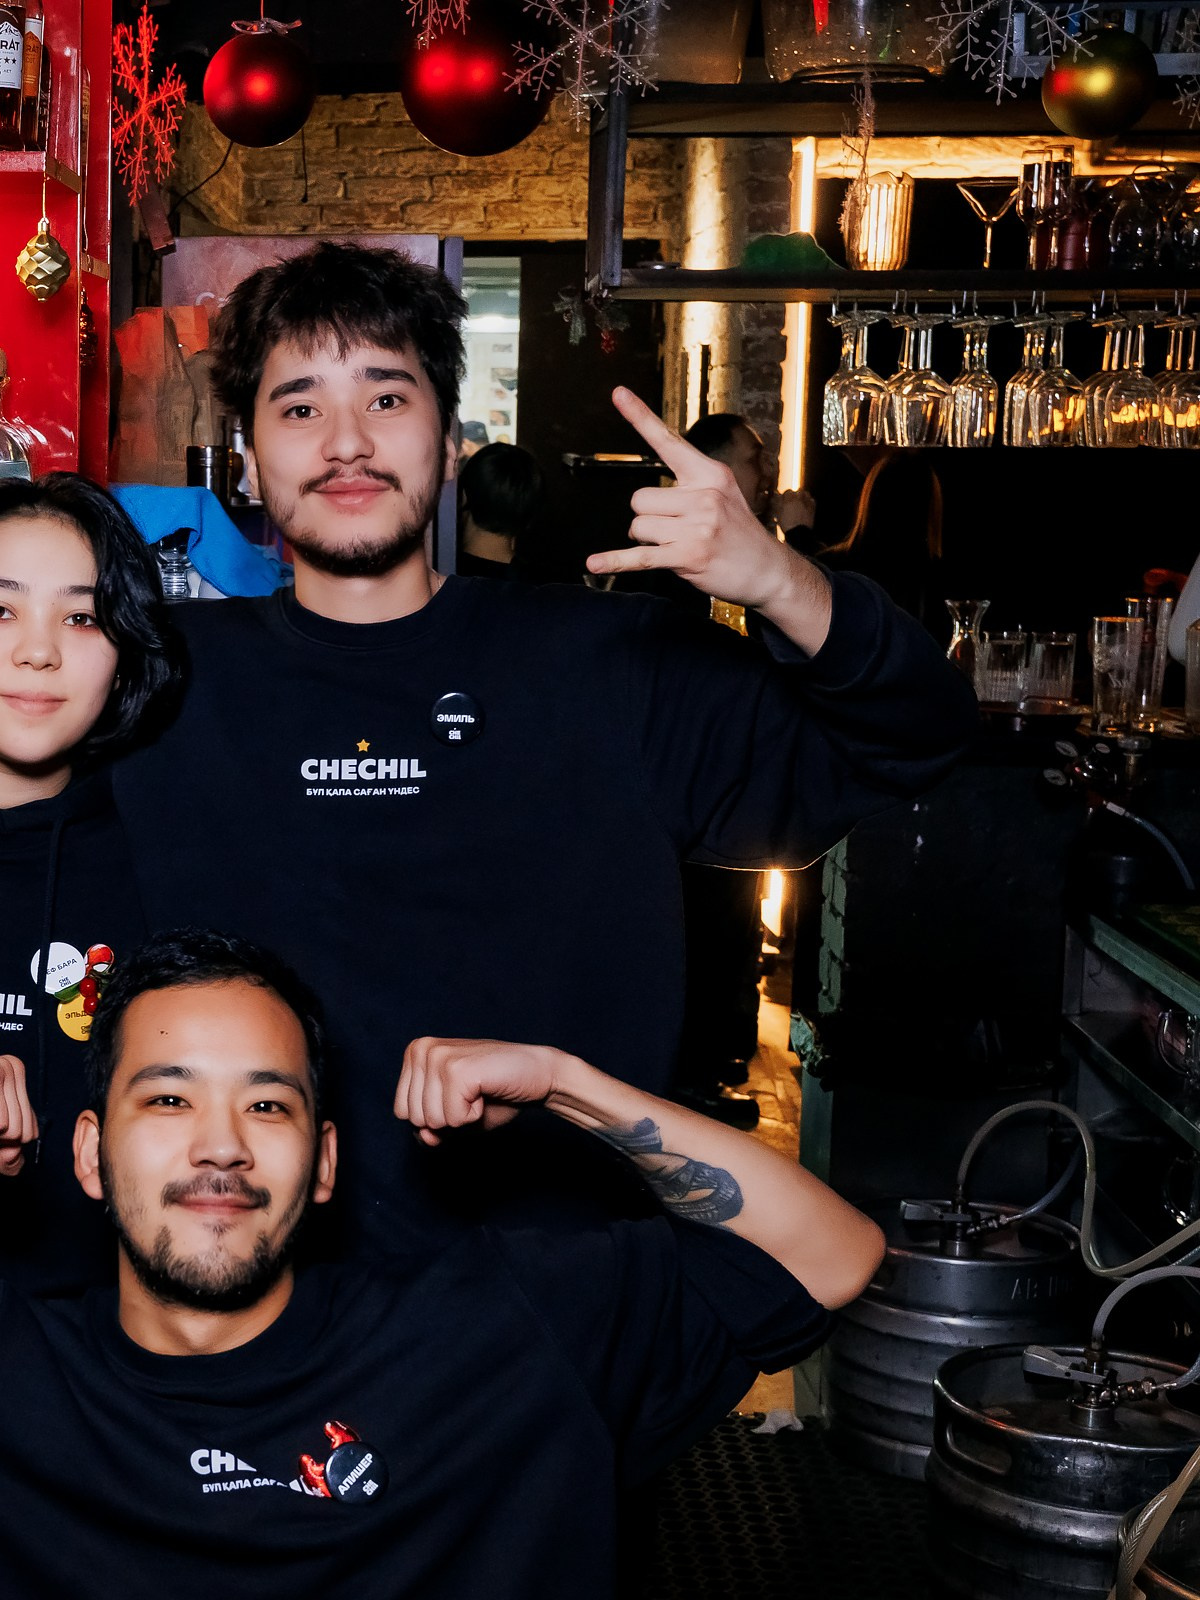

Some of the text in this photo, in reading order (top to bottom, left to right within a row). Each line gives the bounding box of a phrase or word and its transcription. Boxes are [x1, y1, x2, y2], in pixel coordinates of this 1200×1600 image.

[436, 714, 476, 723] ЭМИЛЬ
[300, 758, 427, 781] CHECHIL
[56, 958, 78, 971] БАРА
[338, 1453, 373, 1496] АЛИШЕР
